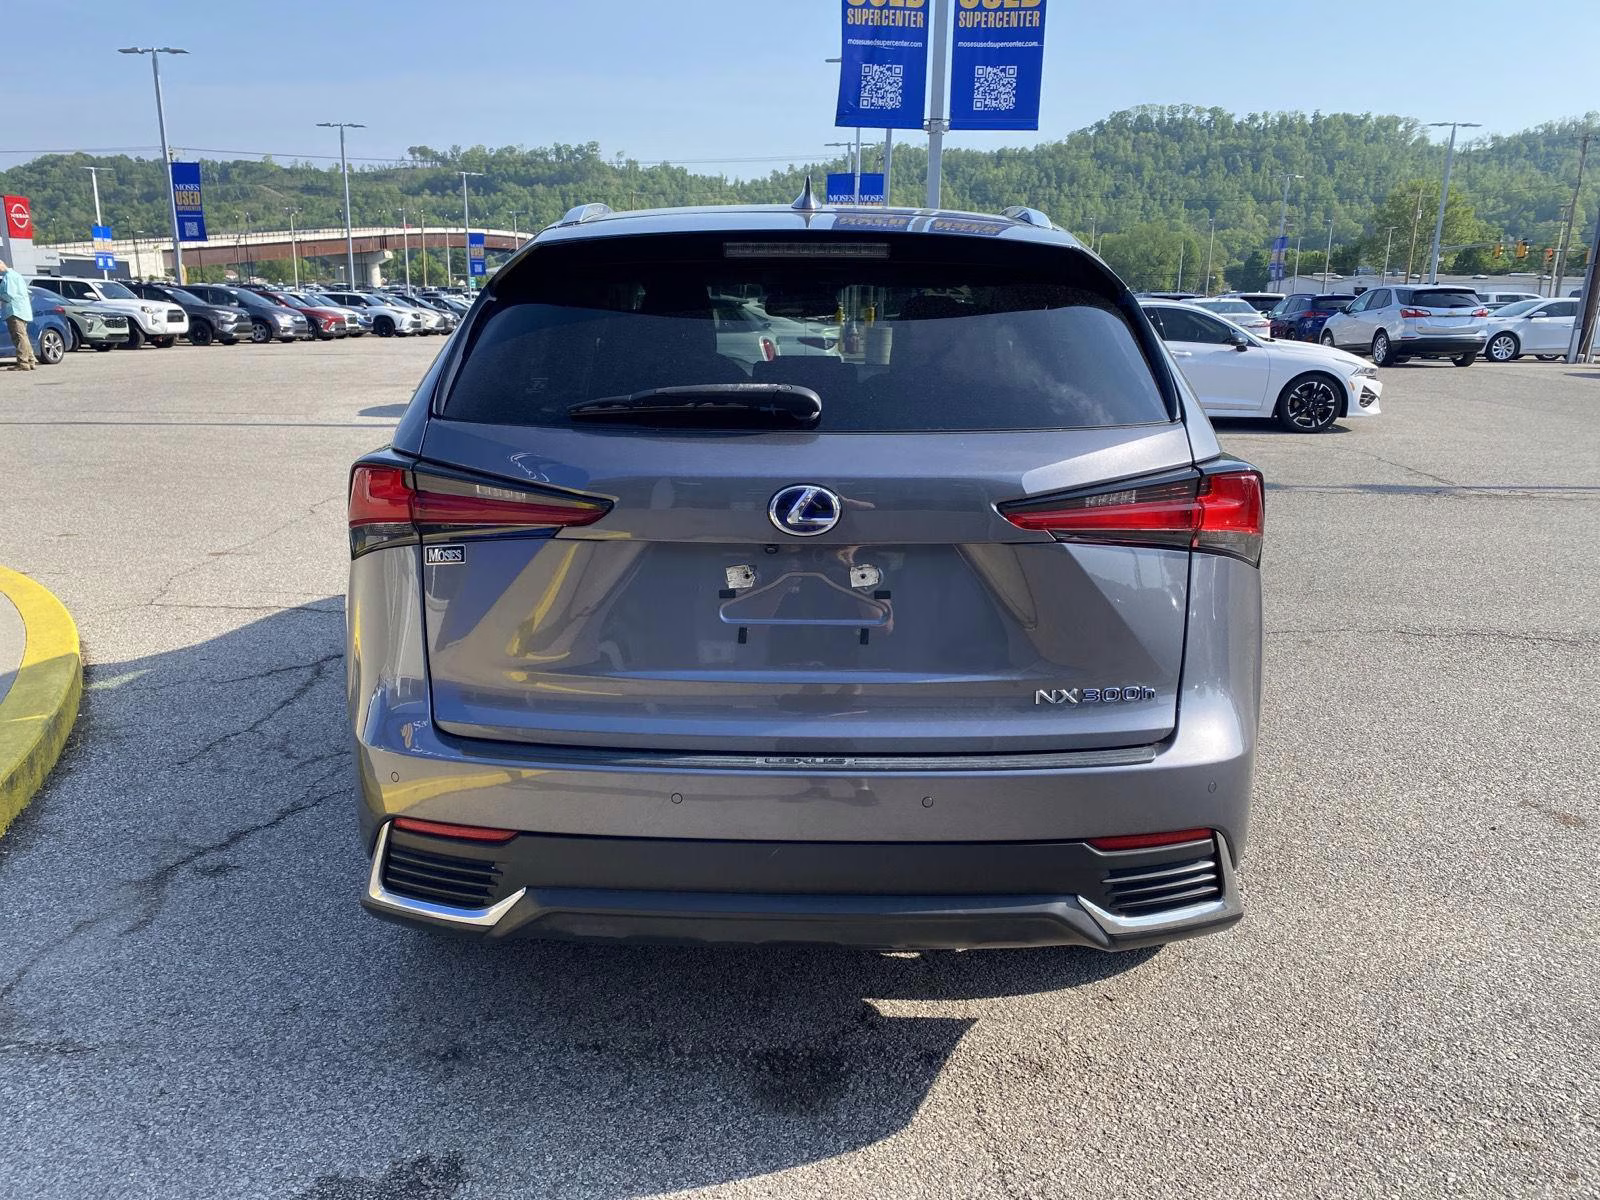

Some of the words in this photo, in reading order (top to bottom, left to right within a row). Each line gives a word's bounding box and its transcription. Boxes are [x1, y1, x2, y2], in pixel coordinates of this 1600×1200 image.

[847, 8, 924, 28] SUPERCENTER
[958, 10, 1041, 28] SUPERCENTER
[847, 38, 923, 48] mosesusedsupercenter.com
[957, 40, 1039, 49] mosesusedsupercenter.com
[174, 183, 200, 191] MOSES
[175, 191, 201, 206] USED
[828, 194, 855, 202] MOSES
[860, 194, 884, 202] MOSES
[428, 548, 462, 562] MOSES
[764, 757, 847, 766] LEXUS
